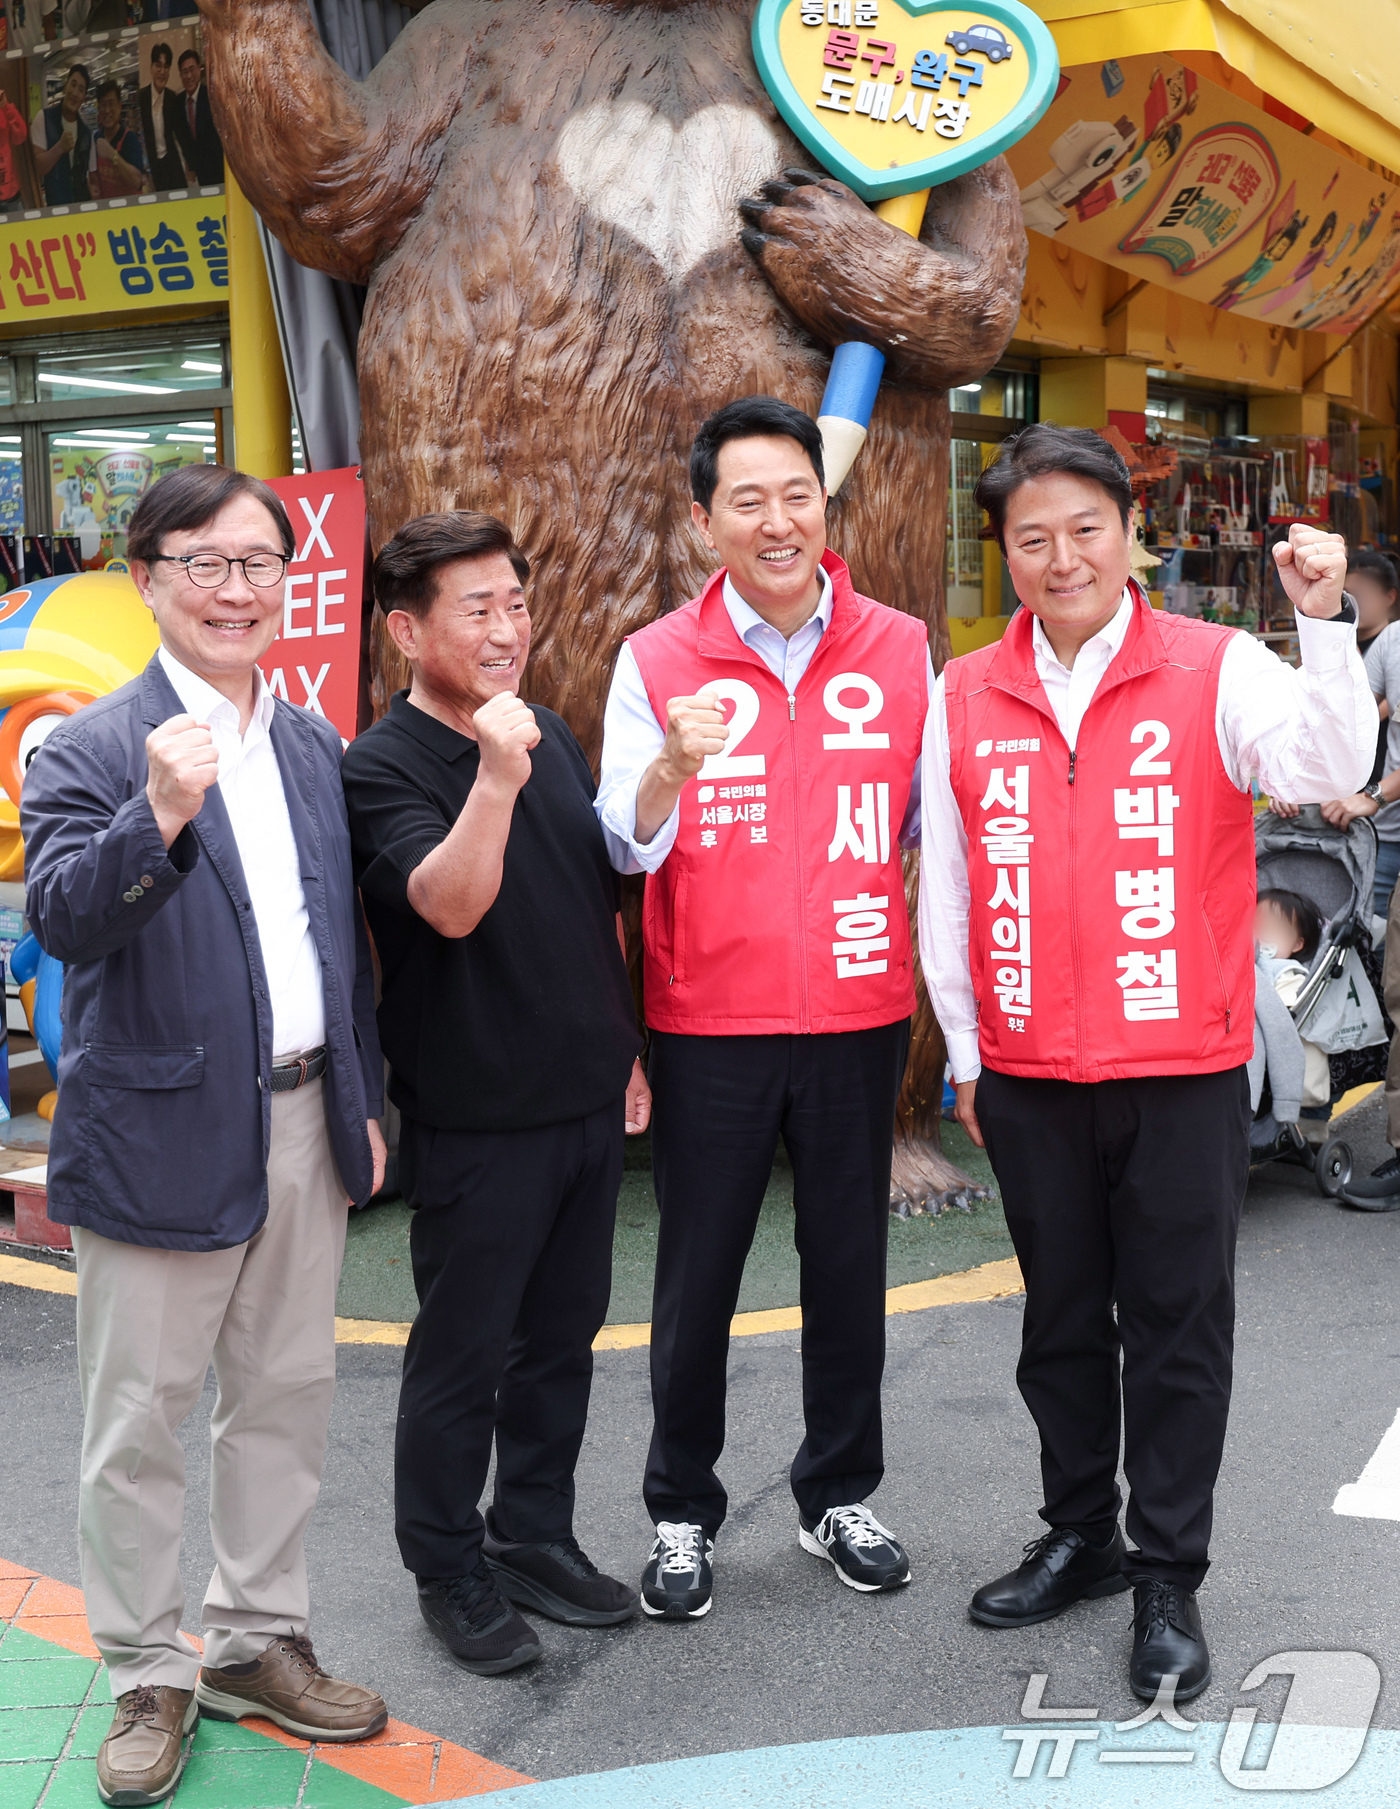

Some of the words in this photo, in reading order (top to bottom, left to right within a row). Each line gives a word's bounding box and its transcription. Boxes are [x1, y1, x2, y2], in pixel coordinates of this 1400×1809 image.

[800, 0, 879, 27] 동대문
[823, 28, 905, 84] 문구,
[911, 49, 984, 97] 완구
[816, 72, 971, 138] 도매시장
[107, 222, 195, 296] 방송
[695, 678, 766, 780] 2
[995, 738, 1040, 753] 국민의힘
[1129, 720, 1171, 777] 2
[699, 803, 767, 825] 서울시장
[718, 783, 767, 799] 국민의힘
[822, 672, 890, 979] 오세훈
[979, 765, 1034, 1016] 서울시의원
[1114, 784, 1180, 1022] 박병철
[1007, 1017, 1025, 1033] 후보
